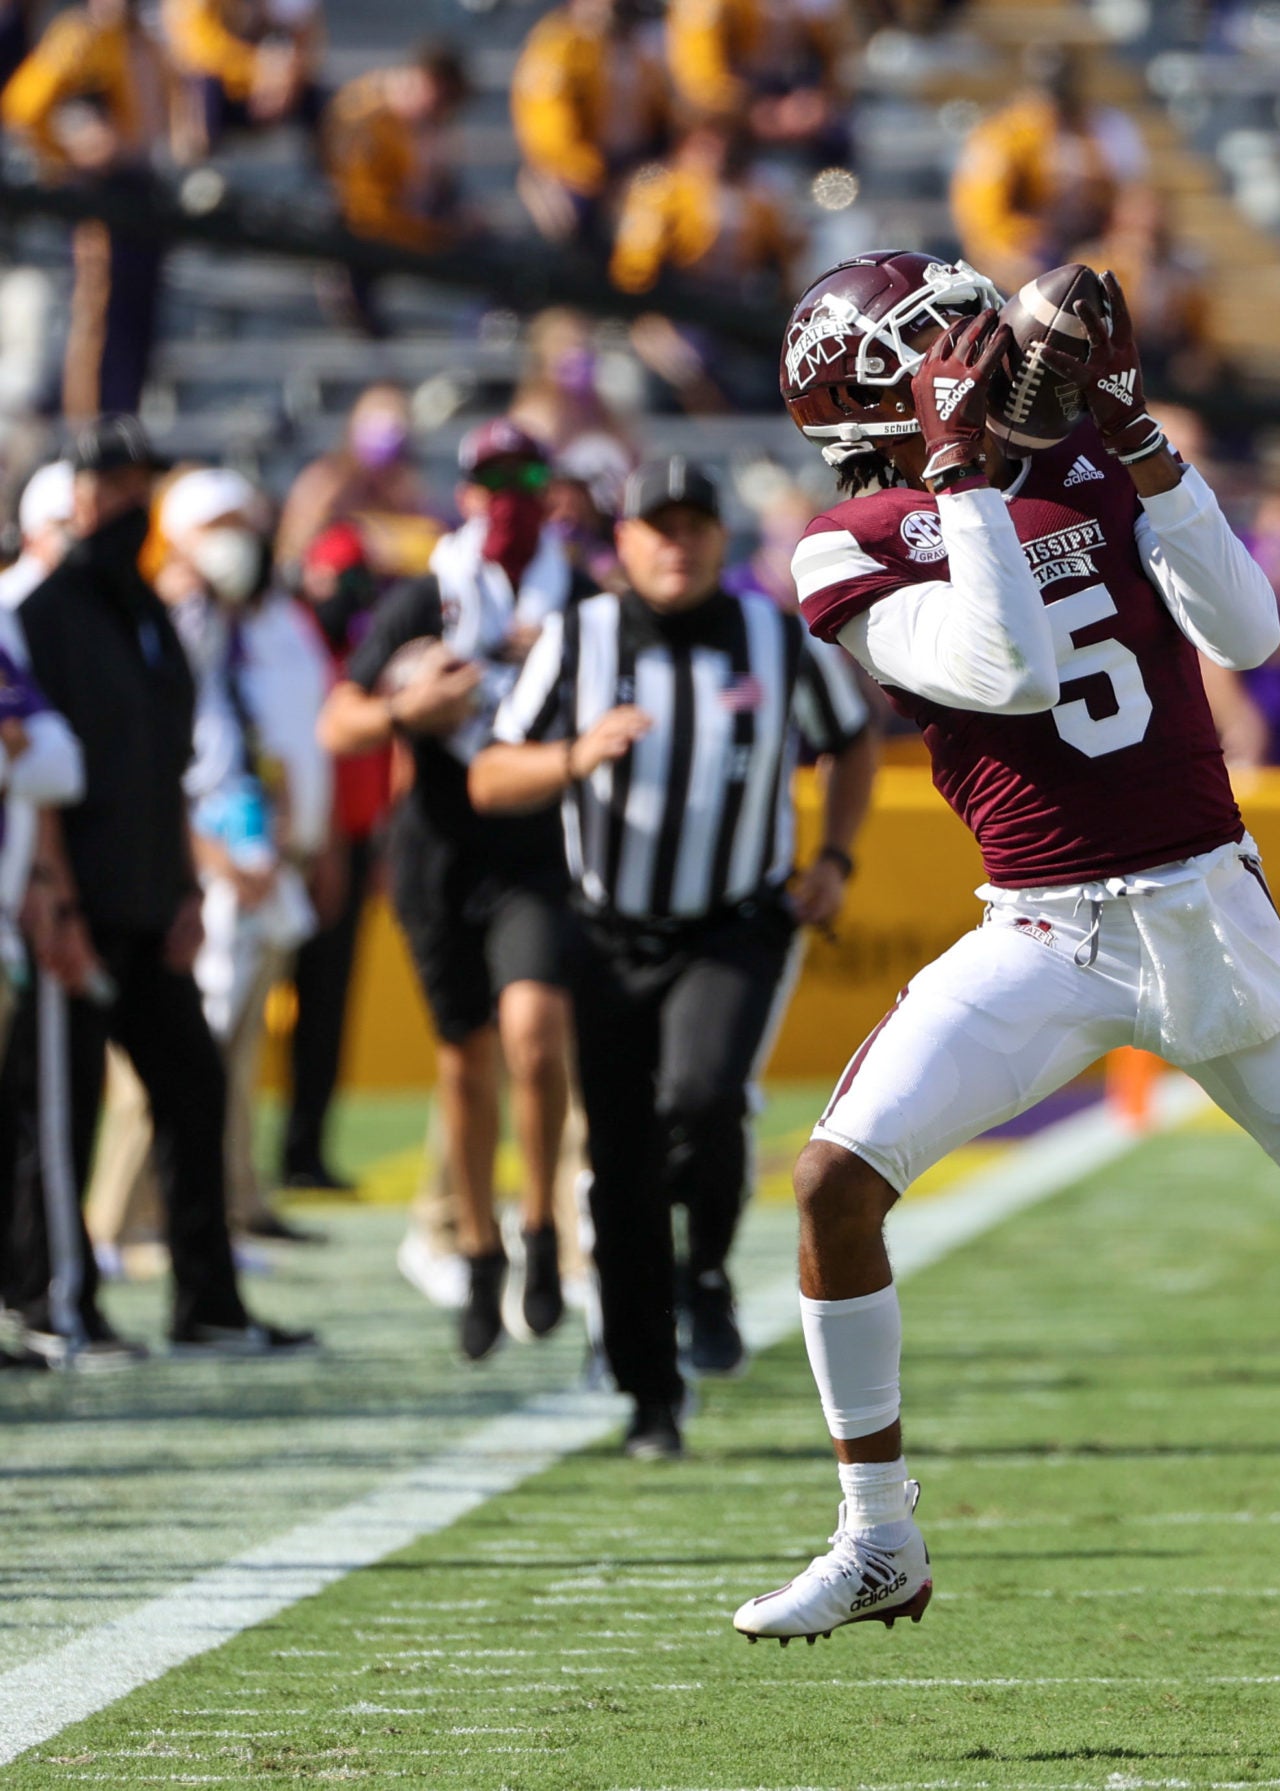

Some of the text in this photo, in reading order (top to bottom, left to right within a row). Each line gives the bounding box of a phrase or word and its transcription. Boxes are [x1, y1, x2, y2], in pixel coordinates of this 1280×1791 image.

[940, 377, 976, 421] adidas
[1097, 378, 1134, 406] adidas
[884, 422, 919, 434] schutt
[1063, 469, 1105, 488] adidas
[919, 549, 946, 561] GRAD
[1024, 523, 1105, 564] ISSIPPI
[1032, 560, 1082, 584] TATE
[1043, 583, 1153, 758] 5
[850, 1572, 907, 1612] adidas
